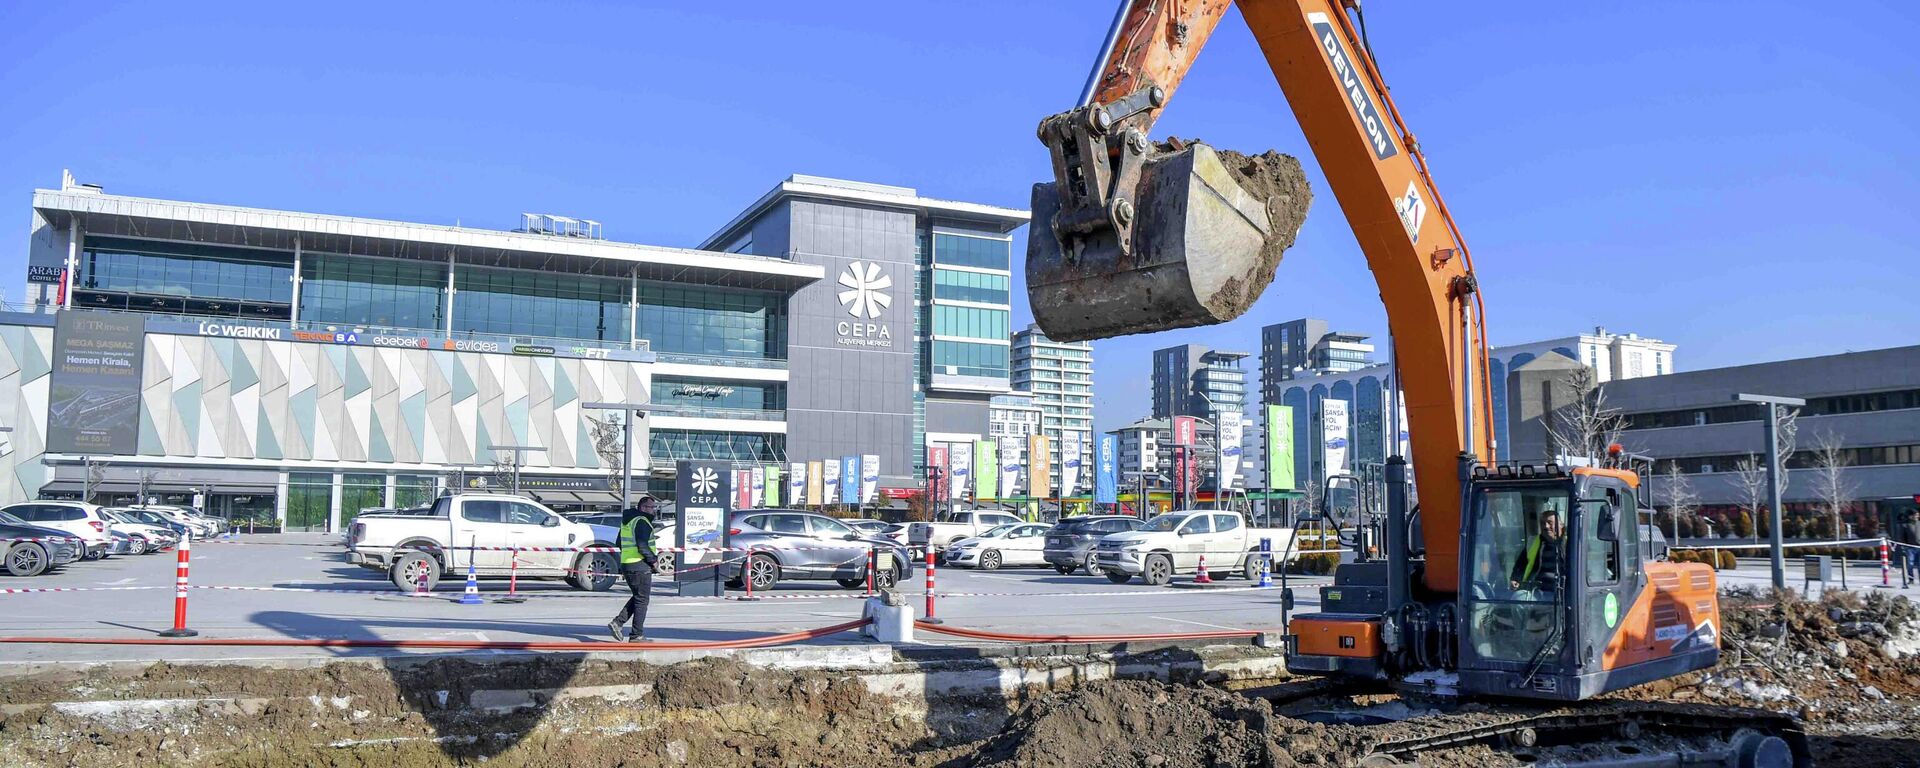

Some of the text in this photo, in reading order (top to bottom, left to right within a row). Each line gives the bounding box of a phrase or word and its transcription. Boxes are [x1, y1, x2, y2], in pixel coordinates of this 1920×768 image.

[1323, 31, 1386, 155] DEVELON
[199, 321, 220, 335] LC
[837, 321, 890, 339] CEPA
[292, 331, 357, 343] TEKNOSA
[373, 336, 419, 348] ebebek
[455, 340, 498, 352] evidea
[66, 355, 131, 367] Hemen Kirala,
[690, 496, 719, 504] CEPA
